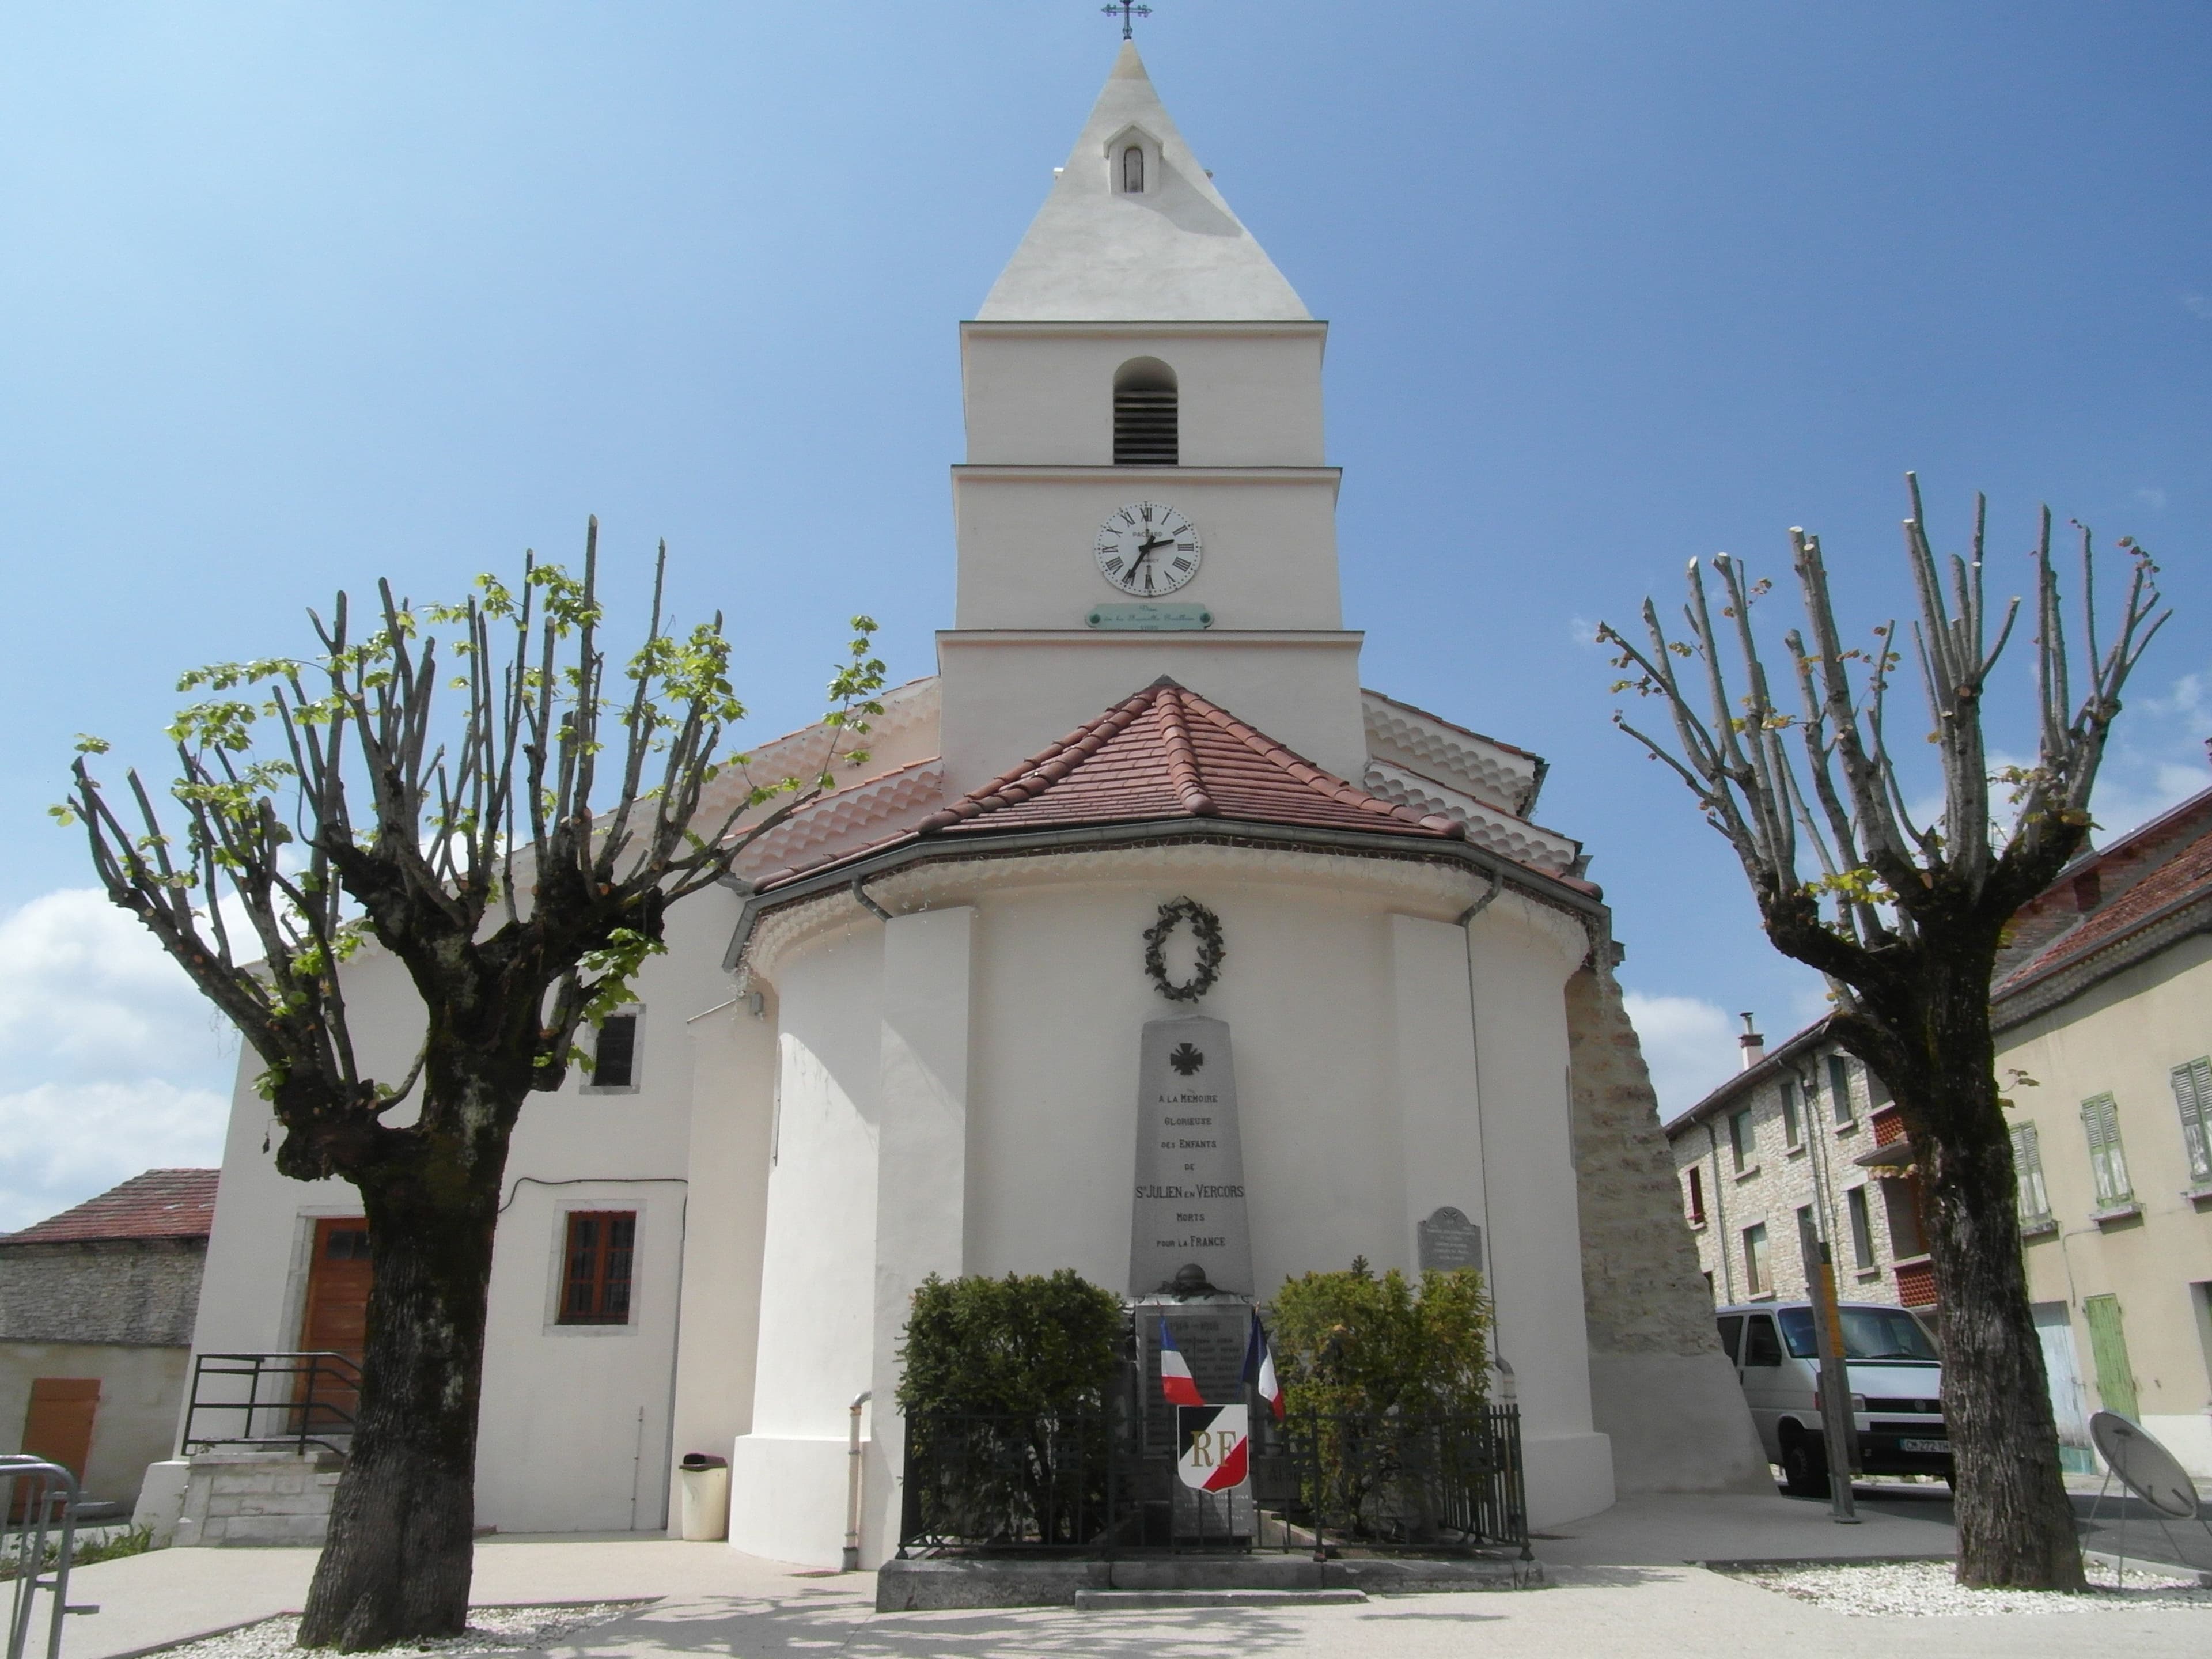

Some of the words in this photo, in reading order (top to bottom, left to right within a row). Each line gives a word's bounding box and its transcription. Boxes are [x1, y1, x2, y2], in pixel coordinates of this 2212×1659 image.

[1107, 526, 1123, 538] X
[1172, 525, 1188, 536] II
[1177, 543, 1194, 551] III
[1181, 1094, 1218, 1103] MEMOIRE
[1164, 1117, 1212, 1126] GLORIEUSE
[1179, 1139, 1217, 1149] ENFANTS
[1146, 1184, 1182, 1199] JULIEN
[1196, 1184, 1245, 1199] VERCORS
[1176, 1213, 1205, 1222] MORTS
[1190, 1236, 1226, 1247] FRANCE
[1190, 1431, 1237, 1467] RF
